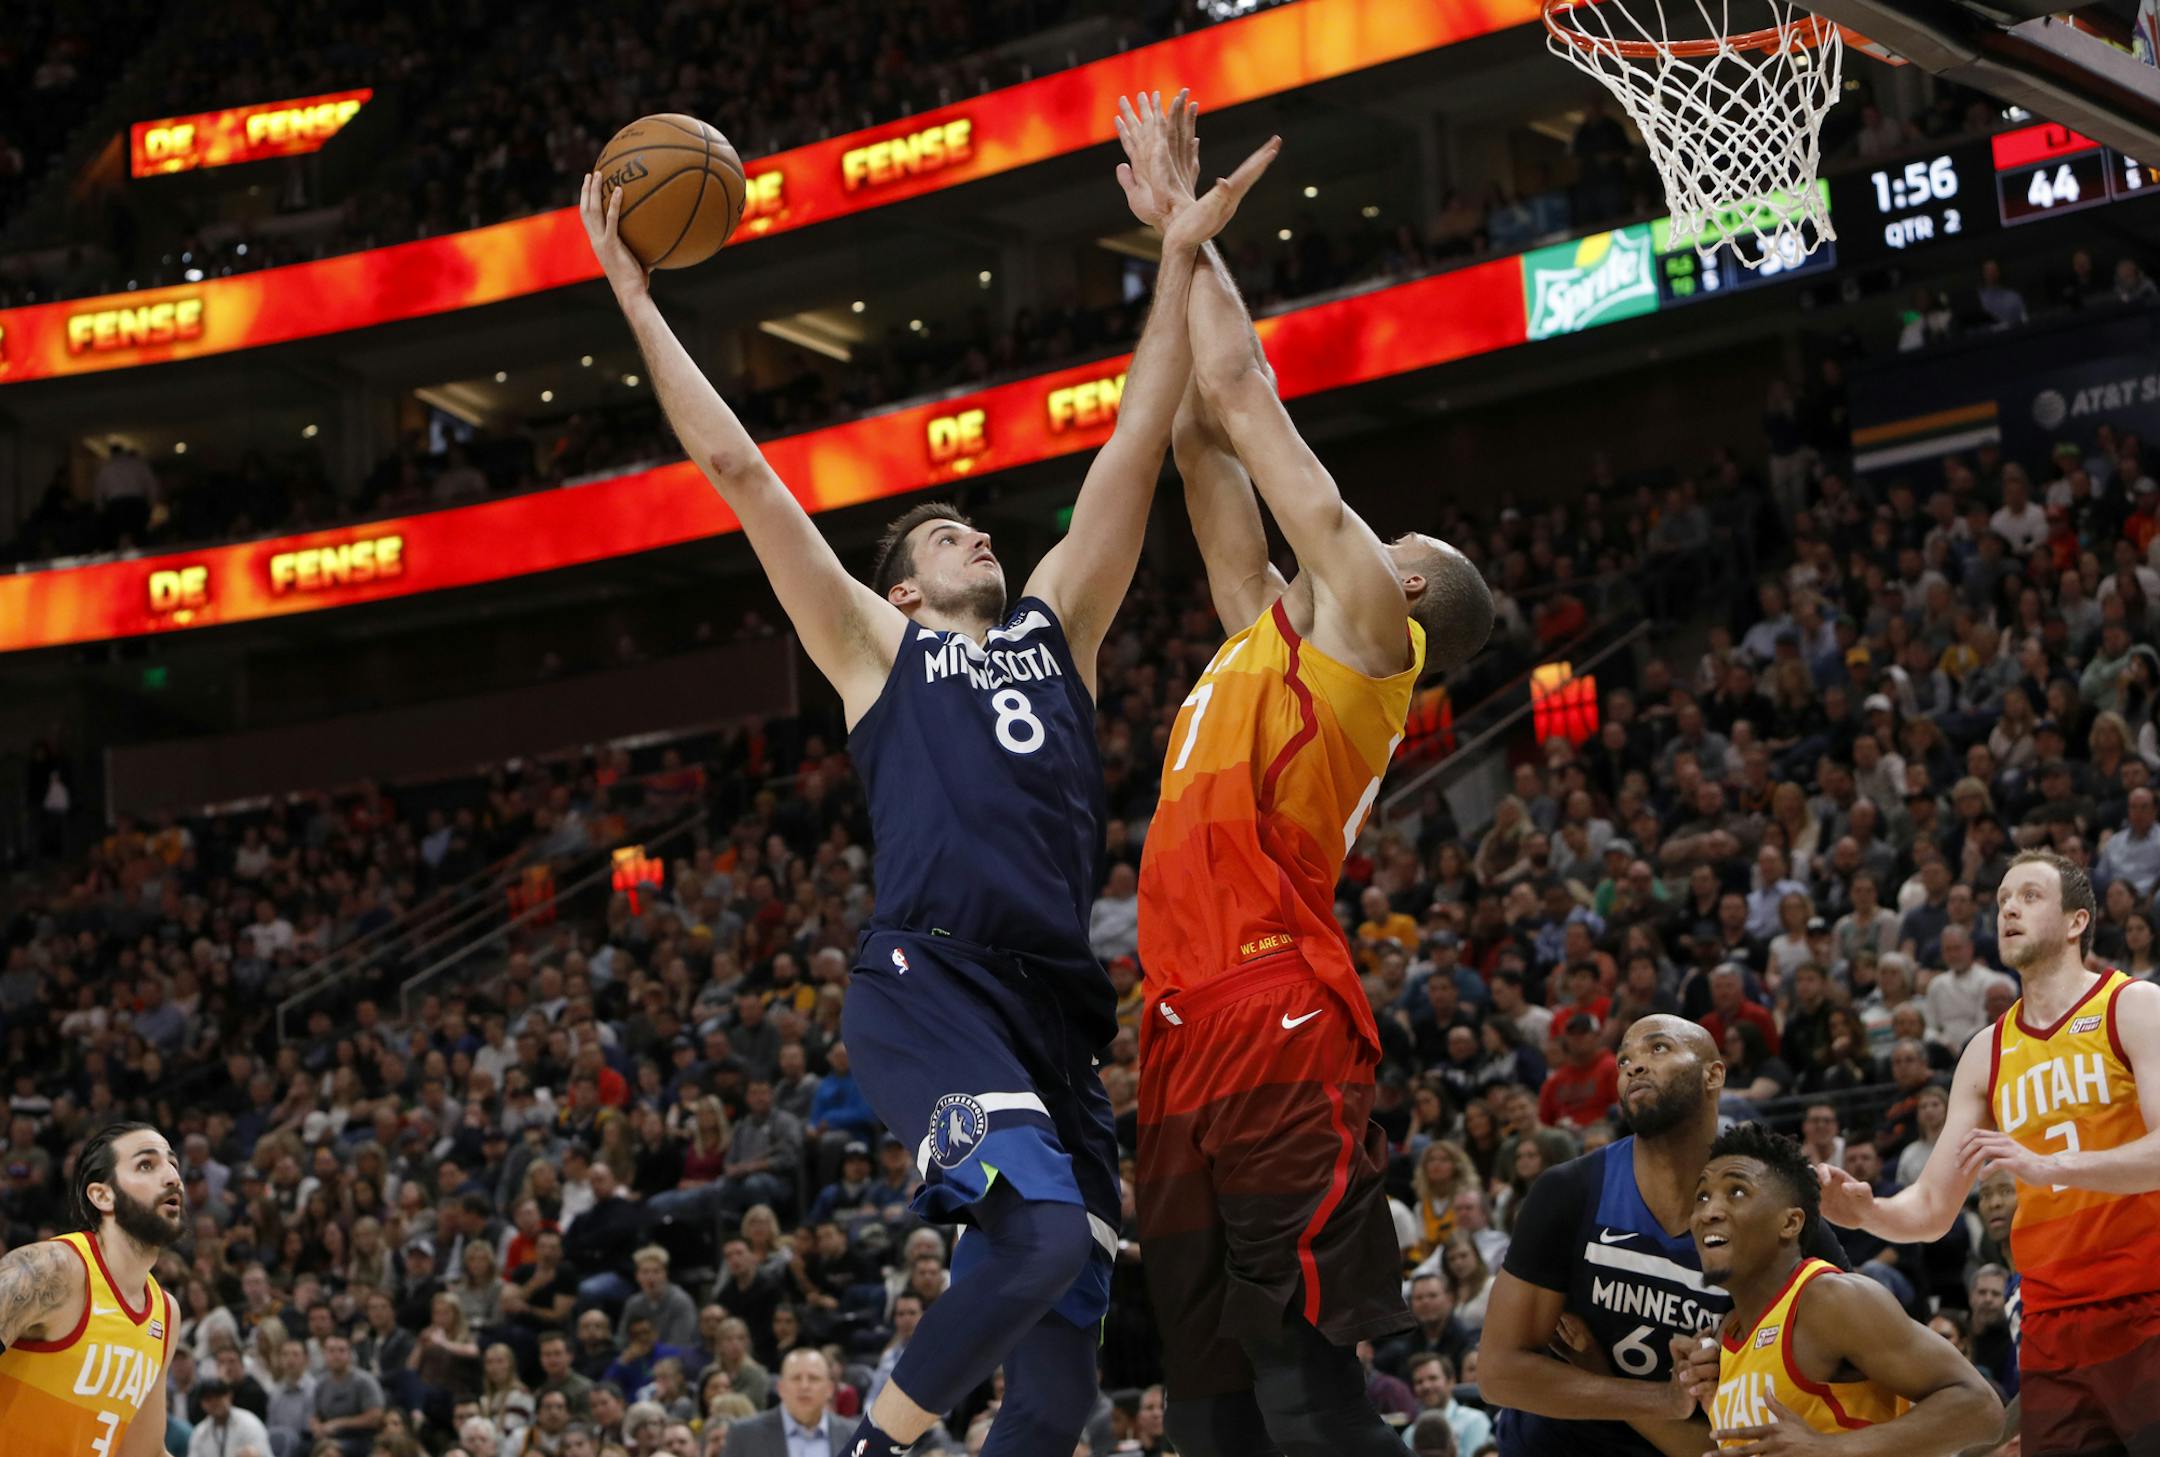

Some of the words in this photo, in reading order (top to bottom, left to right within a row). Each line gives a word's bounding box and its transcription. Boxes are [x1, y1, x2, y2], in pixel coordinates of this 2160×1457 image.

[145, 125, 195, 161] DE
[843, 118, 972, 191] FENSE
[1871, 154, 1958, 213] 1:56
[2028, 163, 2080, 209] 44
[1885, 214, 1934, 249] QTR
[1944, 208, 1962, 234] 2
[1543, 245, 1638, 333] Sprite
[68, 299, 203, 354] FENSE
[2070, 381, 2138, 417] AT&T
[928, 408, 986, 462] DE
[150, 566, 208, 611] DE
[270, 536, 403, 593] FENSE
[925, 643, 1062, 690] MINNESOTA
[992, 689, 1046, 754] 8
[1240, 942, 1257, 955] WE
[1259, 936, 1279, 950] ARE
[2002, 1053, 2110, 1133] UTAH
[73, 1344, 159, 1409] UTAH
[1613, 1325, 1658, 1376] 6
